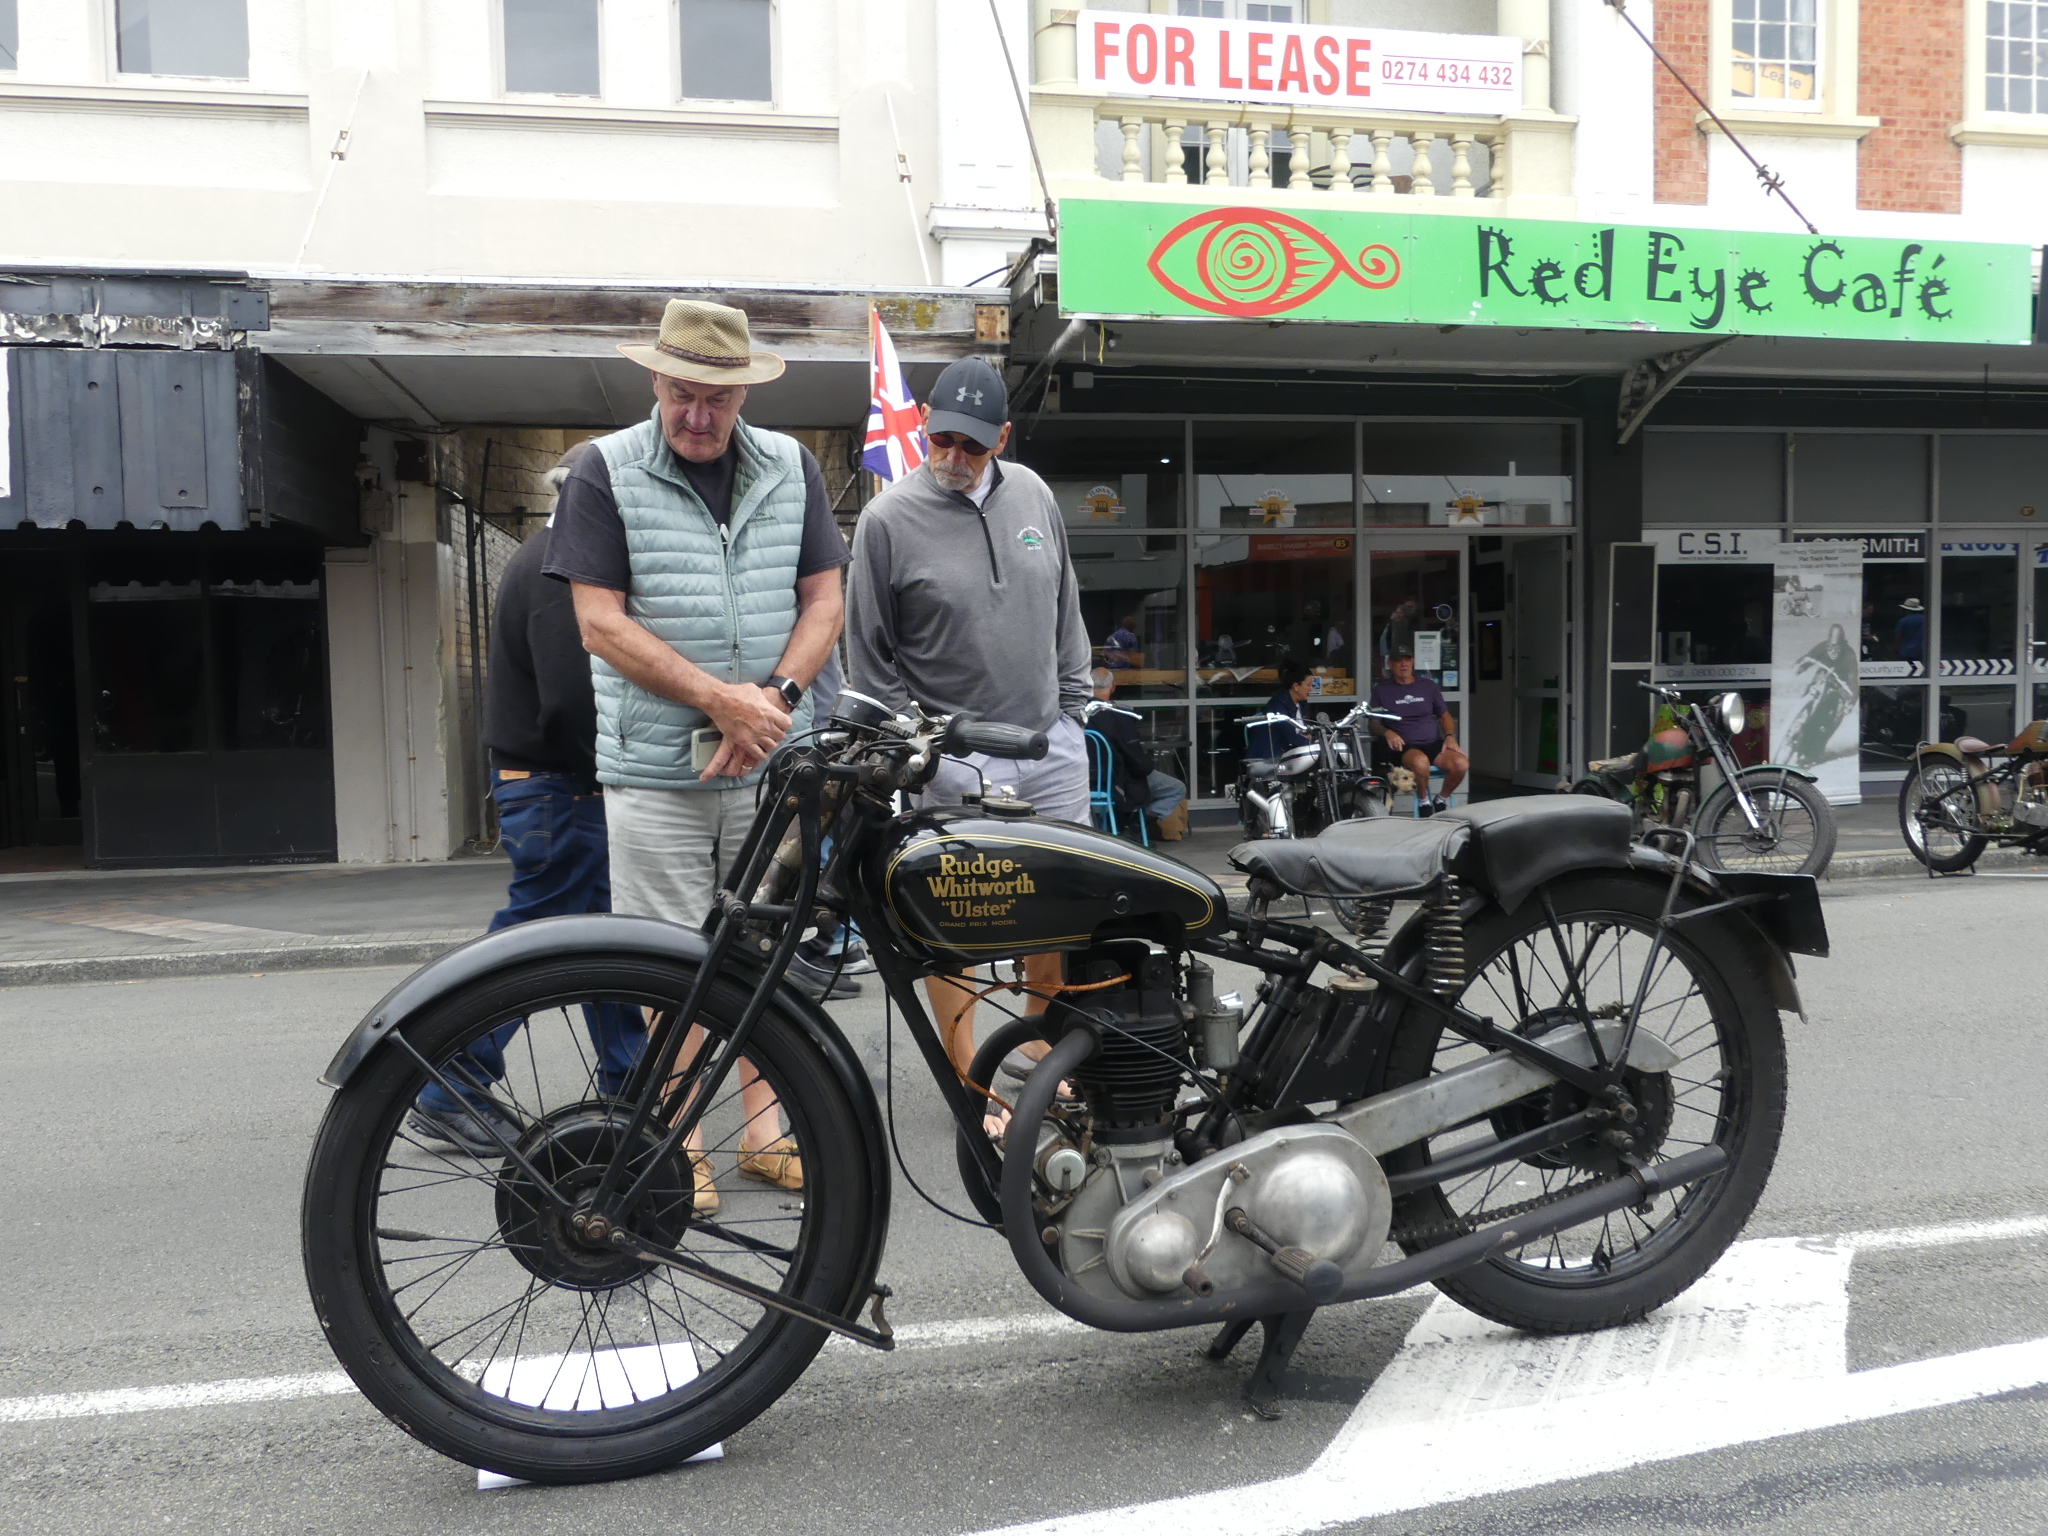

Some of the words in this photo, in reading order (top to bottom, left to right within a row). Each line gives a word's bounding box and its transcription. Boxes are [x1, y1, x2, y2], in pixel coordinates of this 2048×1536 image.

[1094, 21, 1196, 86] FOR
[1218, 30, 1372, 97] LEASE
[1382, 60, 1429, 82] 0274
[1436, 63, 1471, 84] 434
[1478, 66, 1512, 86] 432
[1477, 224, 1615, 308] Red
[1646, 230, 1773, 330] Eye
[1798, 238, 1953, 323] Café
[1678, 532, 1748, 555] C.S.I.
[1800, 538, 1920, 554] SMITH
[940, 853, 1022, 879] Rudge-
[926, 873, 1036, 898] Whitworth
[941, 899, 1017, 918] "Ulster"
